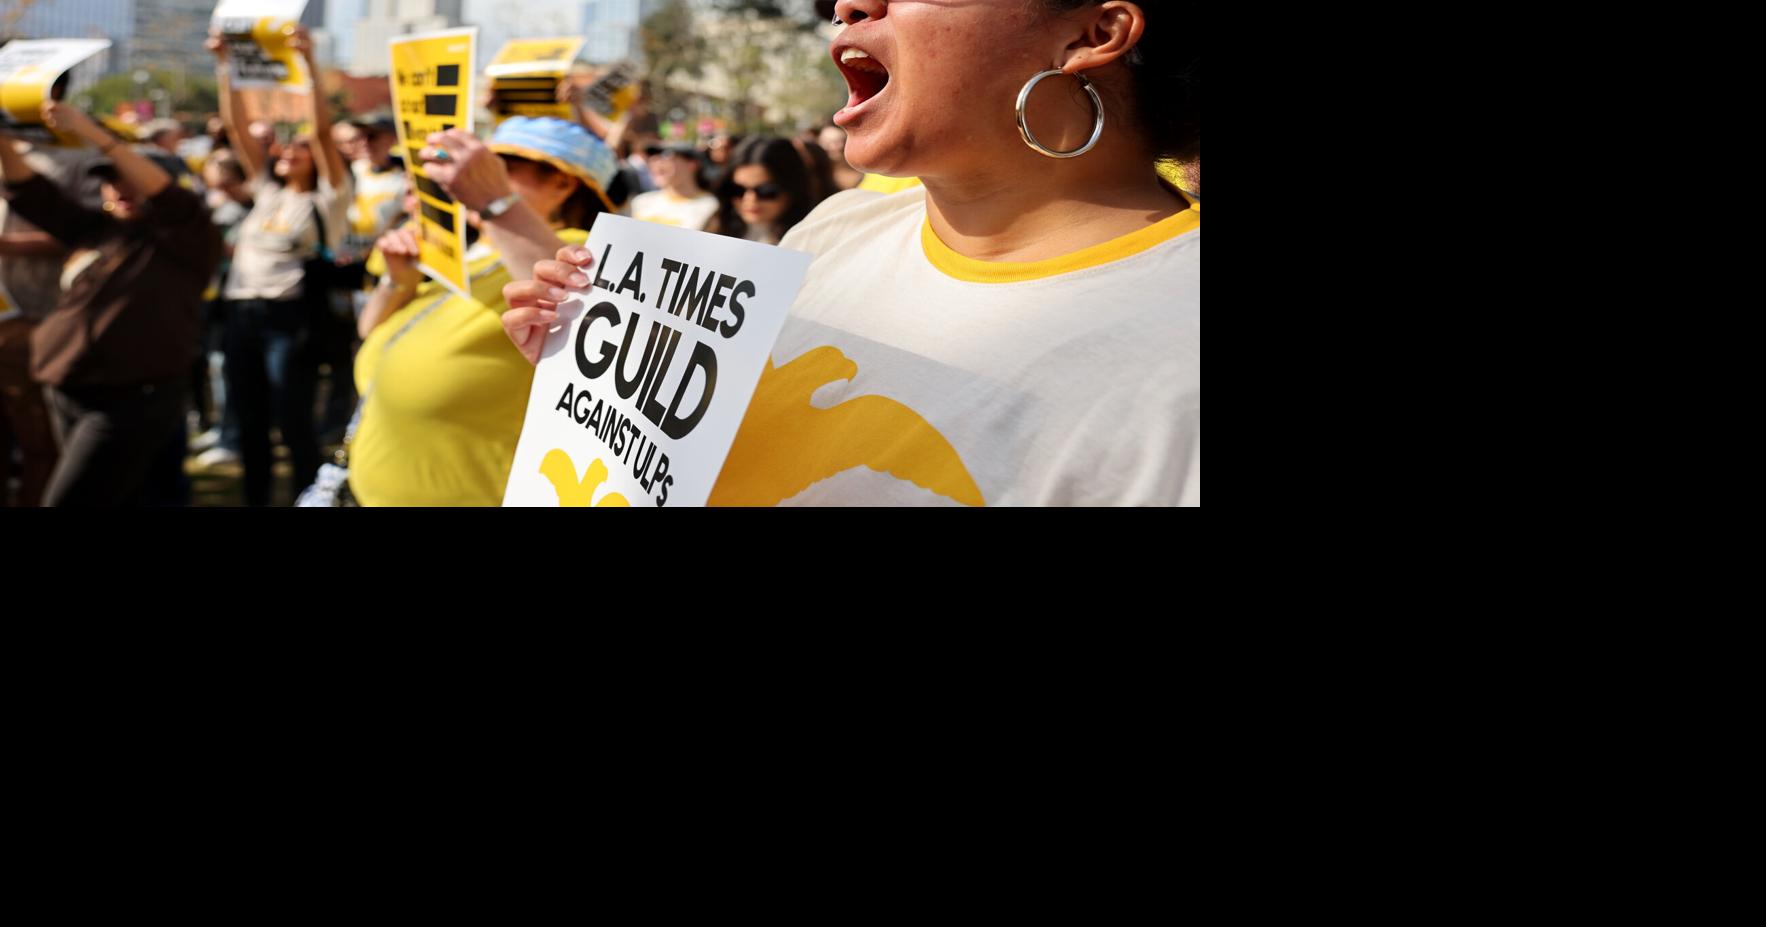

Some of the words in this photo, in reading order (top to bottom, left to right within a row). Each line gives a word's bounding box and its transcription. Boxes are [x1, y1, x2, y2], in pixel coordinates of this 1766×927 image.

[593, 244, 646, 304] L.A.
[656, 257, 756, 340] TIMES
[574, 301, 718, 441] GUILD
[555, 382, 642, 466] AGAINST
